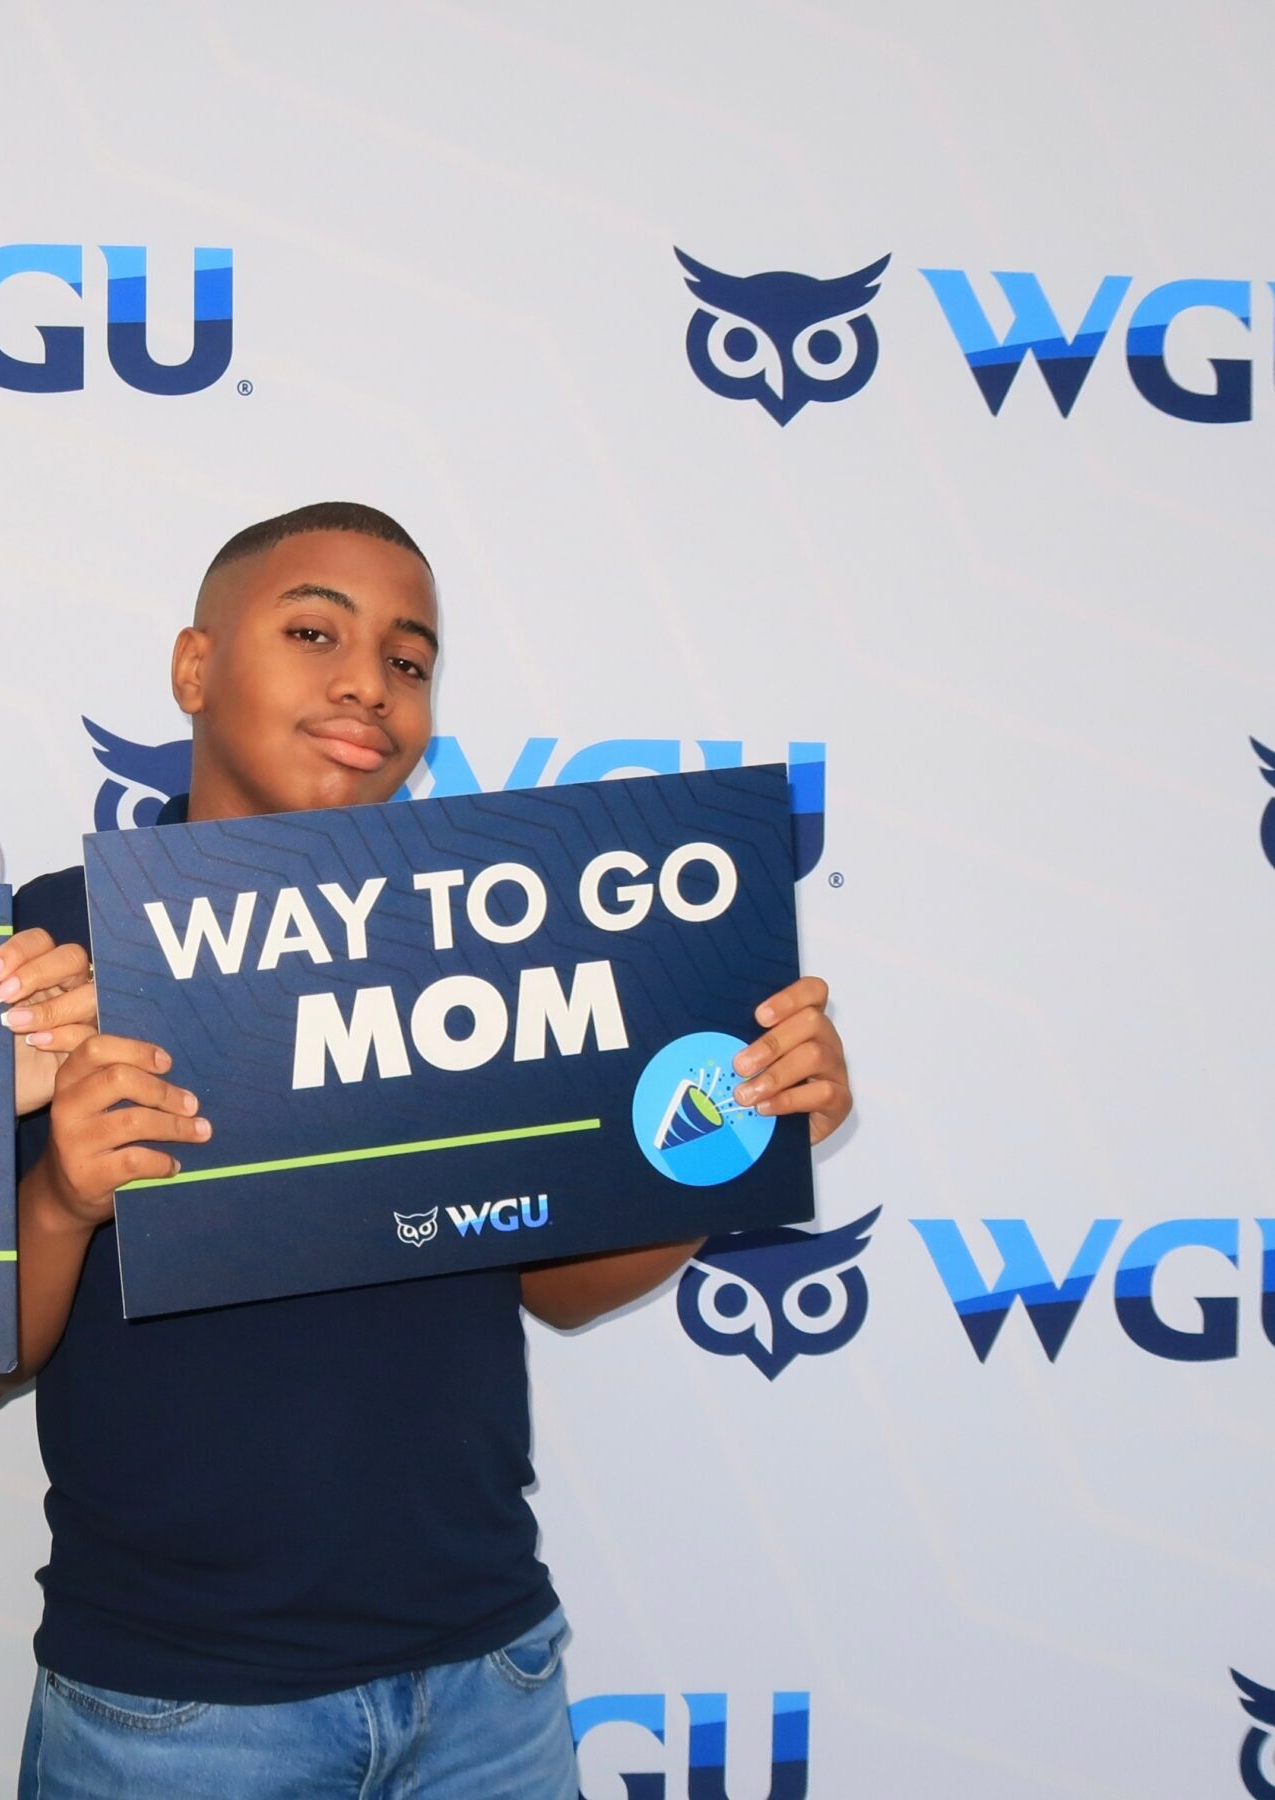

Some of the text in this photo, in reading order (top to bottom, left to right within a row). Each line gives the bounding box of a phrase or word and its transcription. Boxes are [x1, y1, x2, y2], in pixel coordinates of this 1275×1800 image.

[916, 268, 1275, 424] WG
[144, 842, 738, 979] WAY TO GO
[292, 960, 629, 1090] MOM
[445, 1194, 549, 1237] WGU
[908, 1219, 1275, 1364] WG
[569, 1691, 810, 1800] GU
